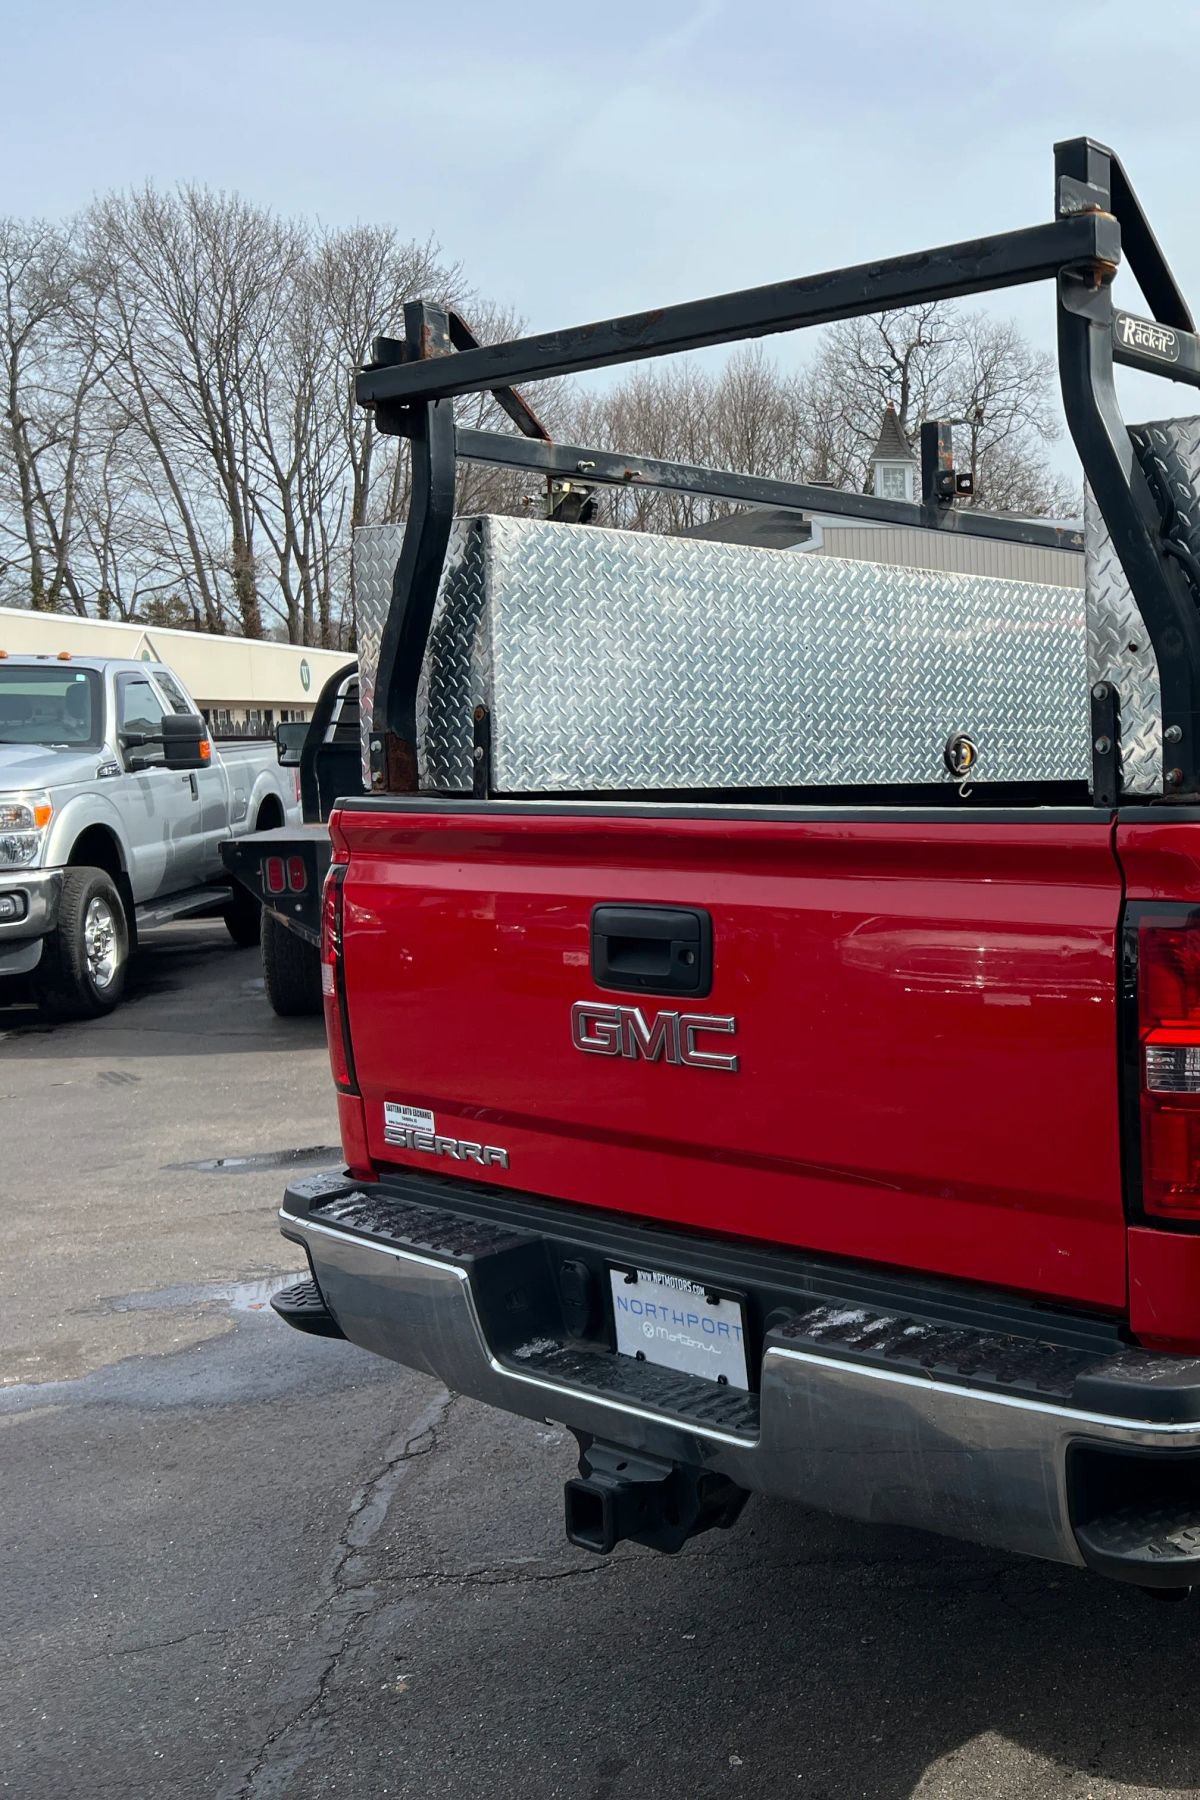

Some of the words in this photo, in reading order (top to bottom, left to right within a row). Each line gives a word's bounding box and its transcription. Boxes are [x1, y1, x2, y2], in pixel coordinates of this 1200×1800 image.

[571, 1000, 739, 1072] GMC
[384, 1126, 509, 1169] SIERRA
[616, 1295, 743, 1342] NORTHPORT
[655, 1326, 722, 1355] Motors
